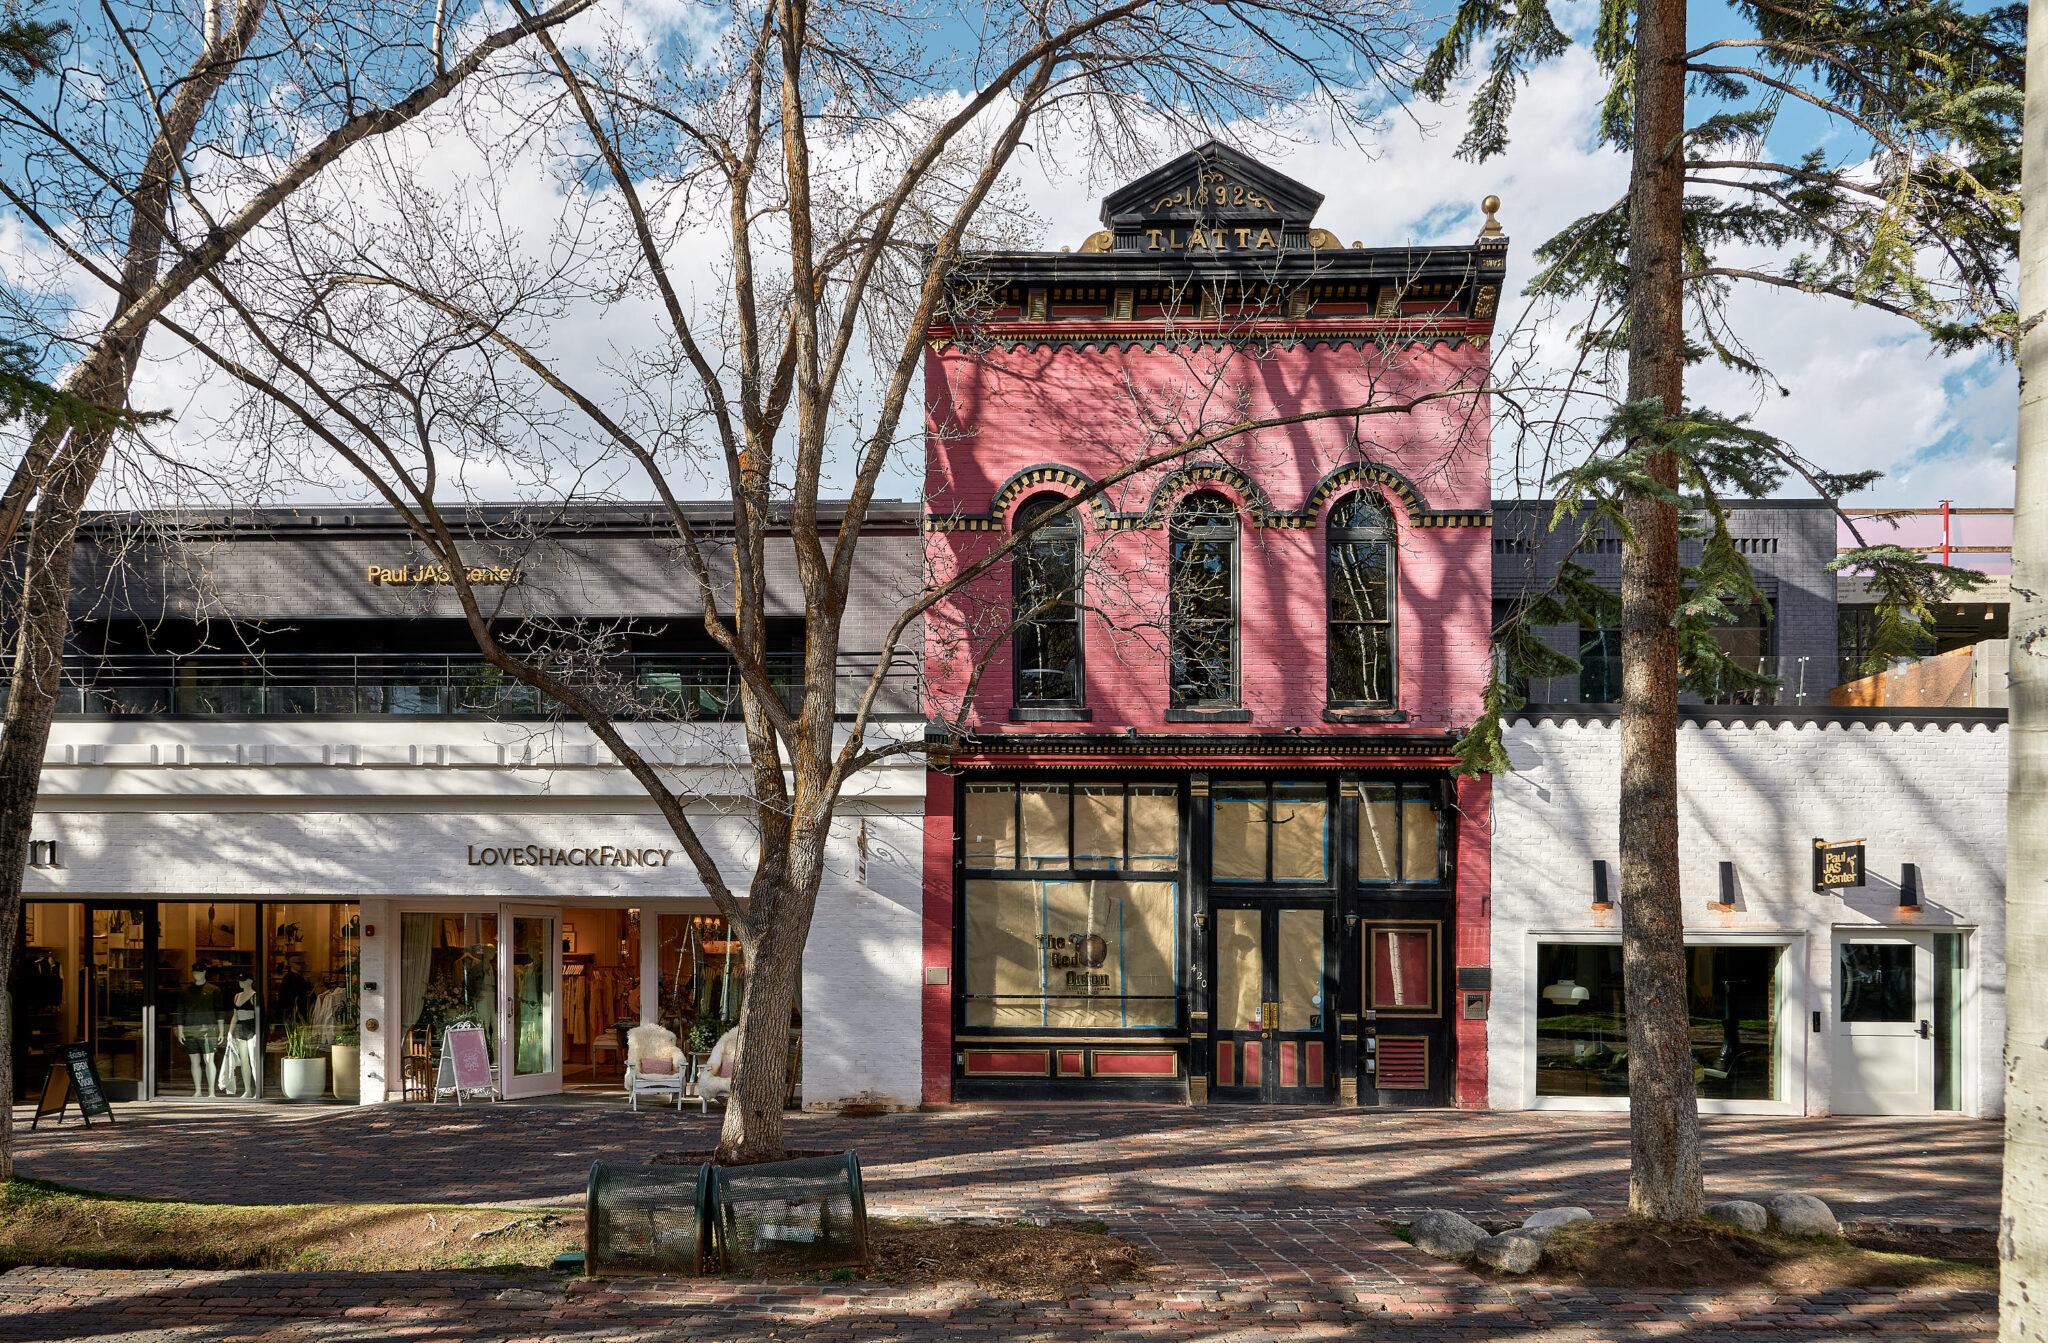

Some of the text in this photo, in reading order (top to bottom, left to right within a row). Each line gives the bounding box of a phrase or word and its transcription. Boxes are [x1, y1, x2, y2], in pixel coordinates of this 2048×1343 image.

[1185, 185, 1245, 206] 1892
[368, 564, 408, 583] Paul
[464, 565, 519, 582] ente
[1825, 851, 1846, 864] Paul
[1823, 862, 1842, 875] JAS
[1824, 872, 1857, 884] Center
[1035, 933, 1066, 950] The
[1050, 952, 1081, 969] Red
